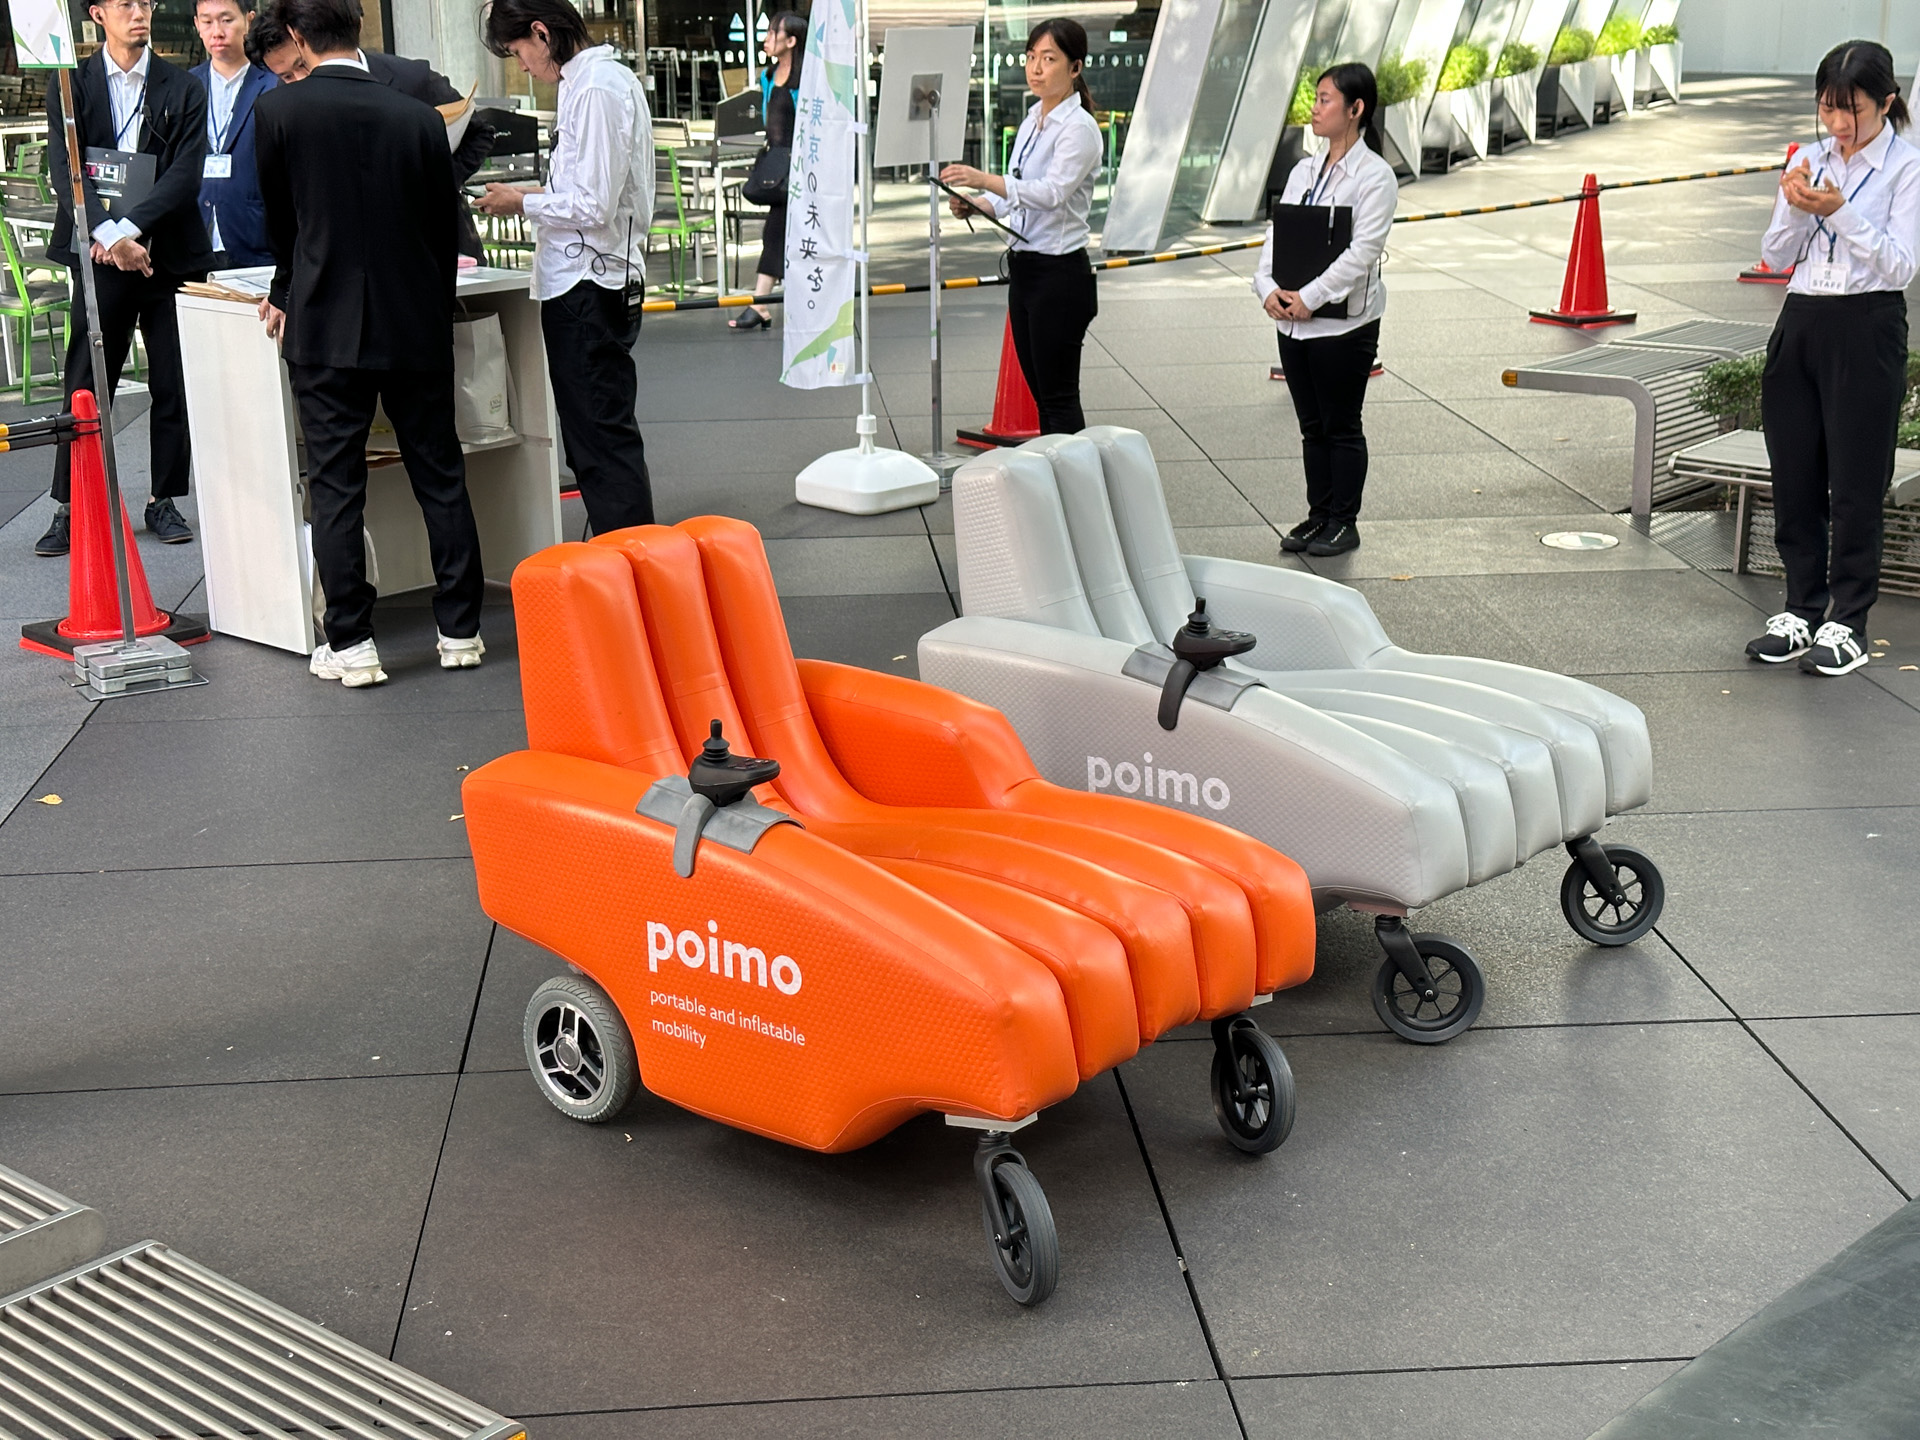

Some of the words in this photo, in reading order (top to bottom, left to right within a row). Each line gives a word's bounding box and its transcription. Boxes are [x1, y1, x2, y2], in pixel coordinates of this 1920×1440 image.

[1812, 279, 1842, 290] STAFF
[1087, 752, 1231, 811] poimo
[646, 919, 803, 996] poimo
[650, 990, 707, 1017] portable
[709, 1008, 736, 1026] and
[738, 1011, 806, 1047] inflatable
[651, 1018, 707, 1050] mobility
